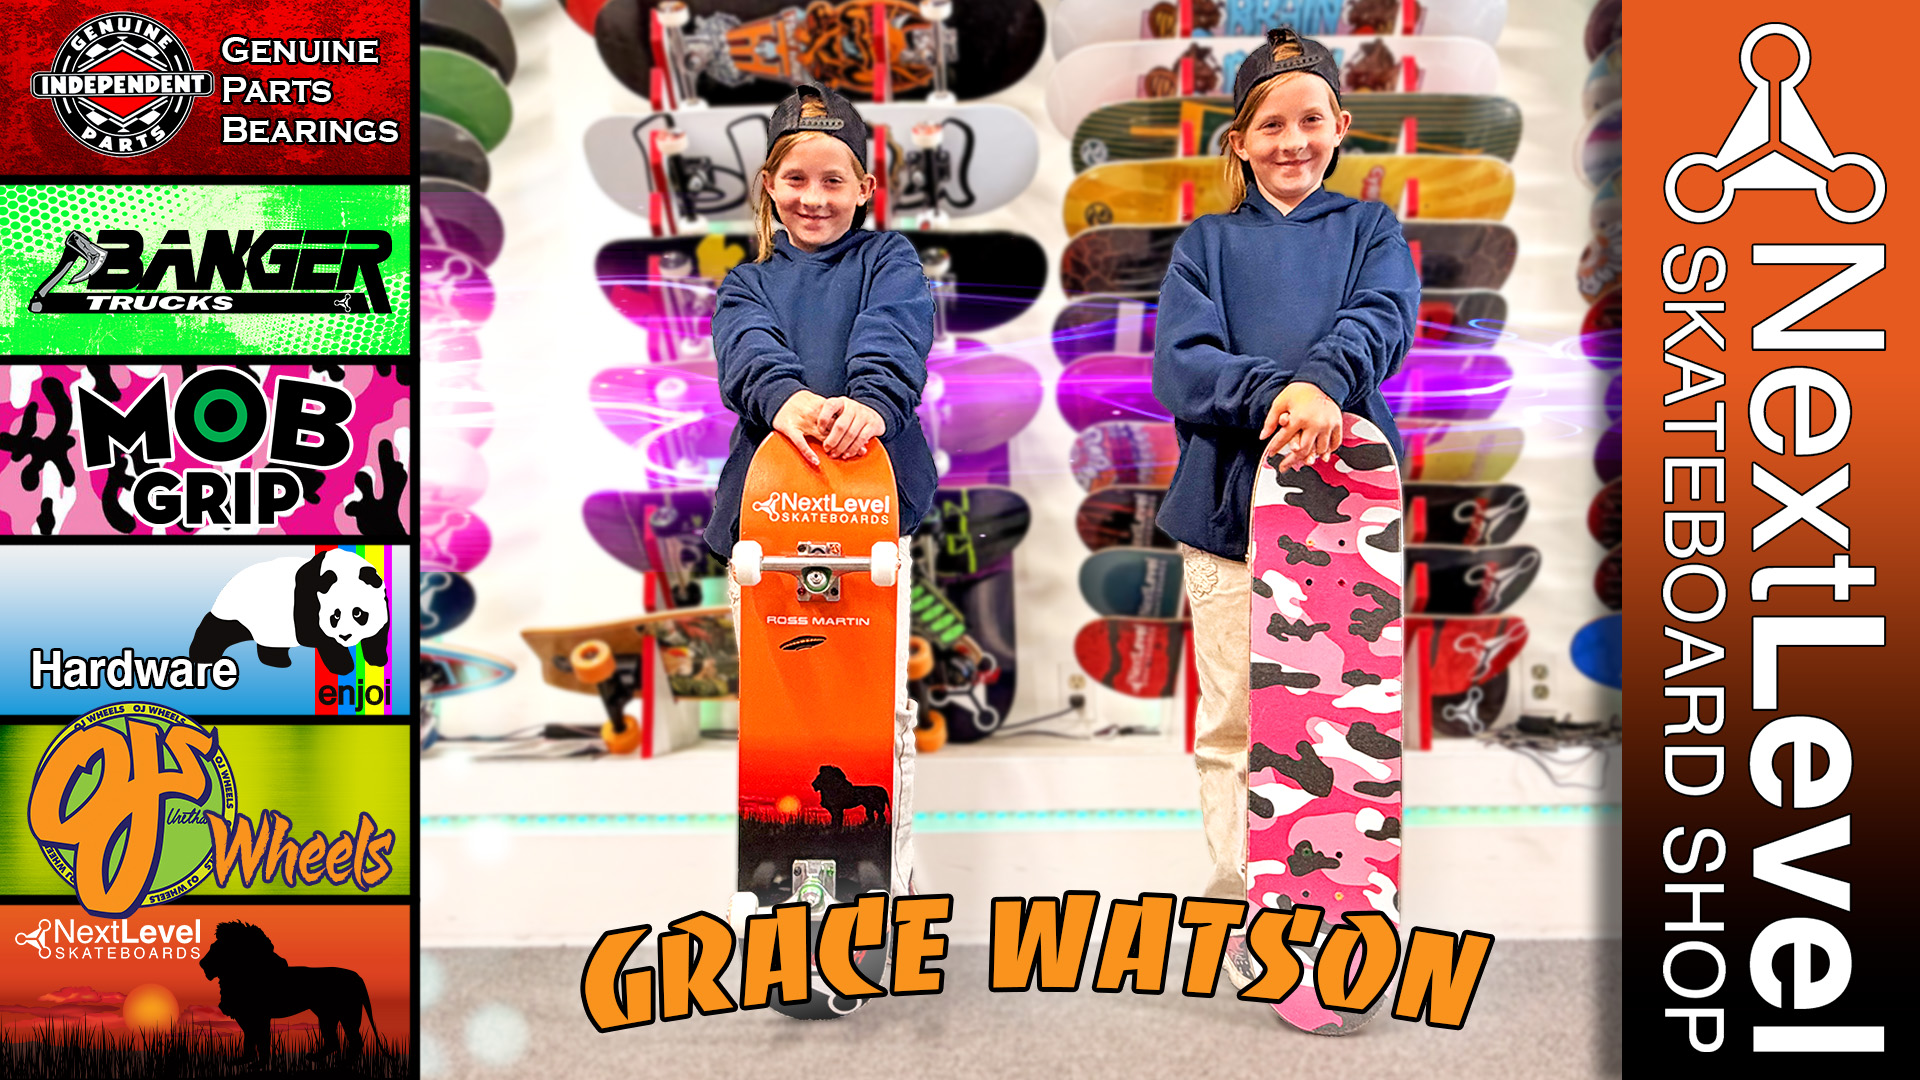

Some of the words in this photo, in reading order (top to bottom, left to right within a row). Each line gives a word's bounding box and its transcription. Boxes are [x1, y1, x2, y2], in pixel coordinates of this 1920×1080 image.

[781, 492, 890, 514] NextLevel
[781, 512, 889, 525] SKATEBOARDS
[766, 615, 809, 626] ROSS
[812, 616, 870, 626] MARTIN
